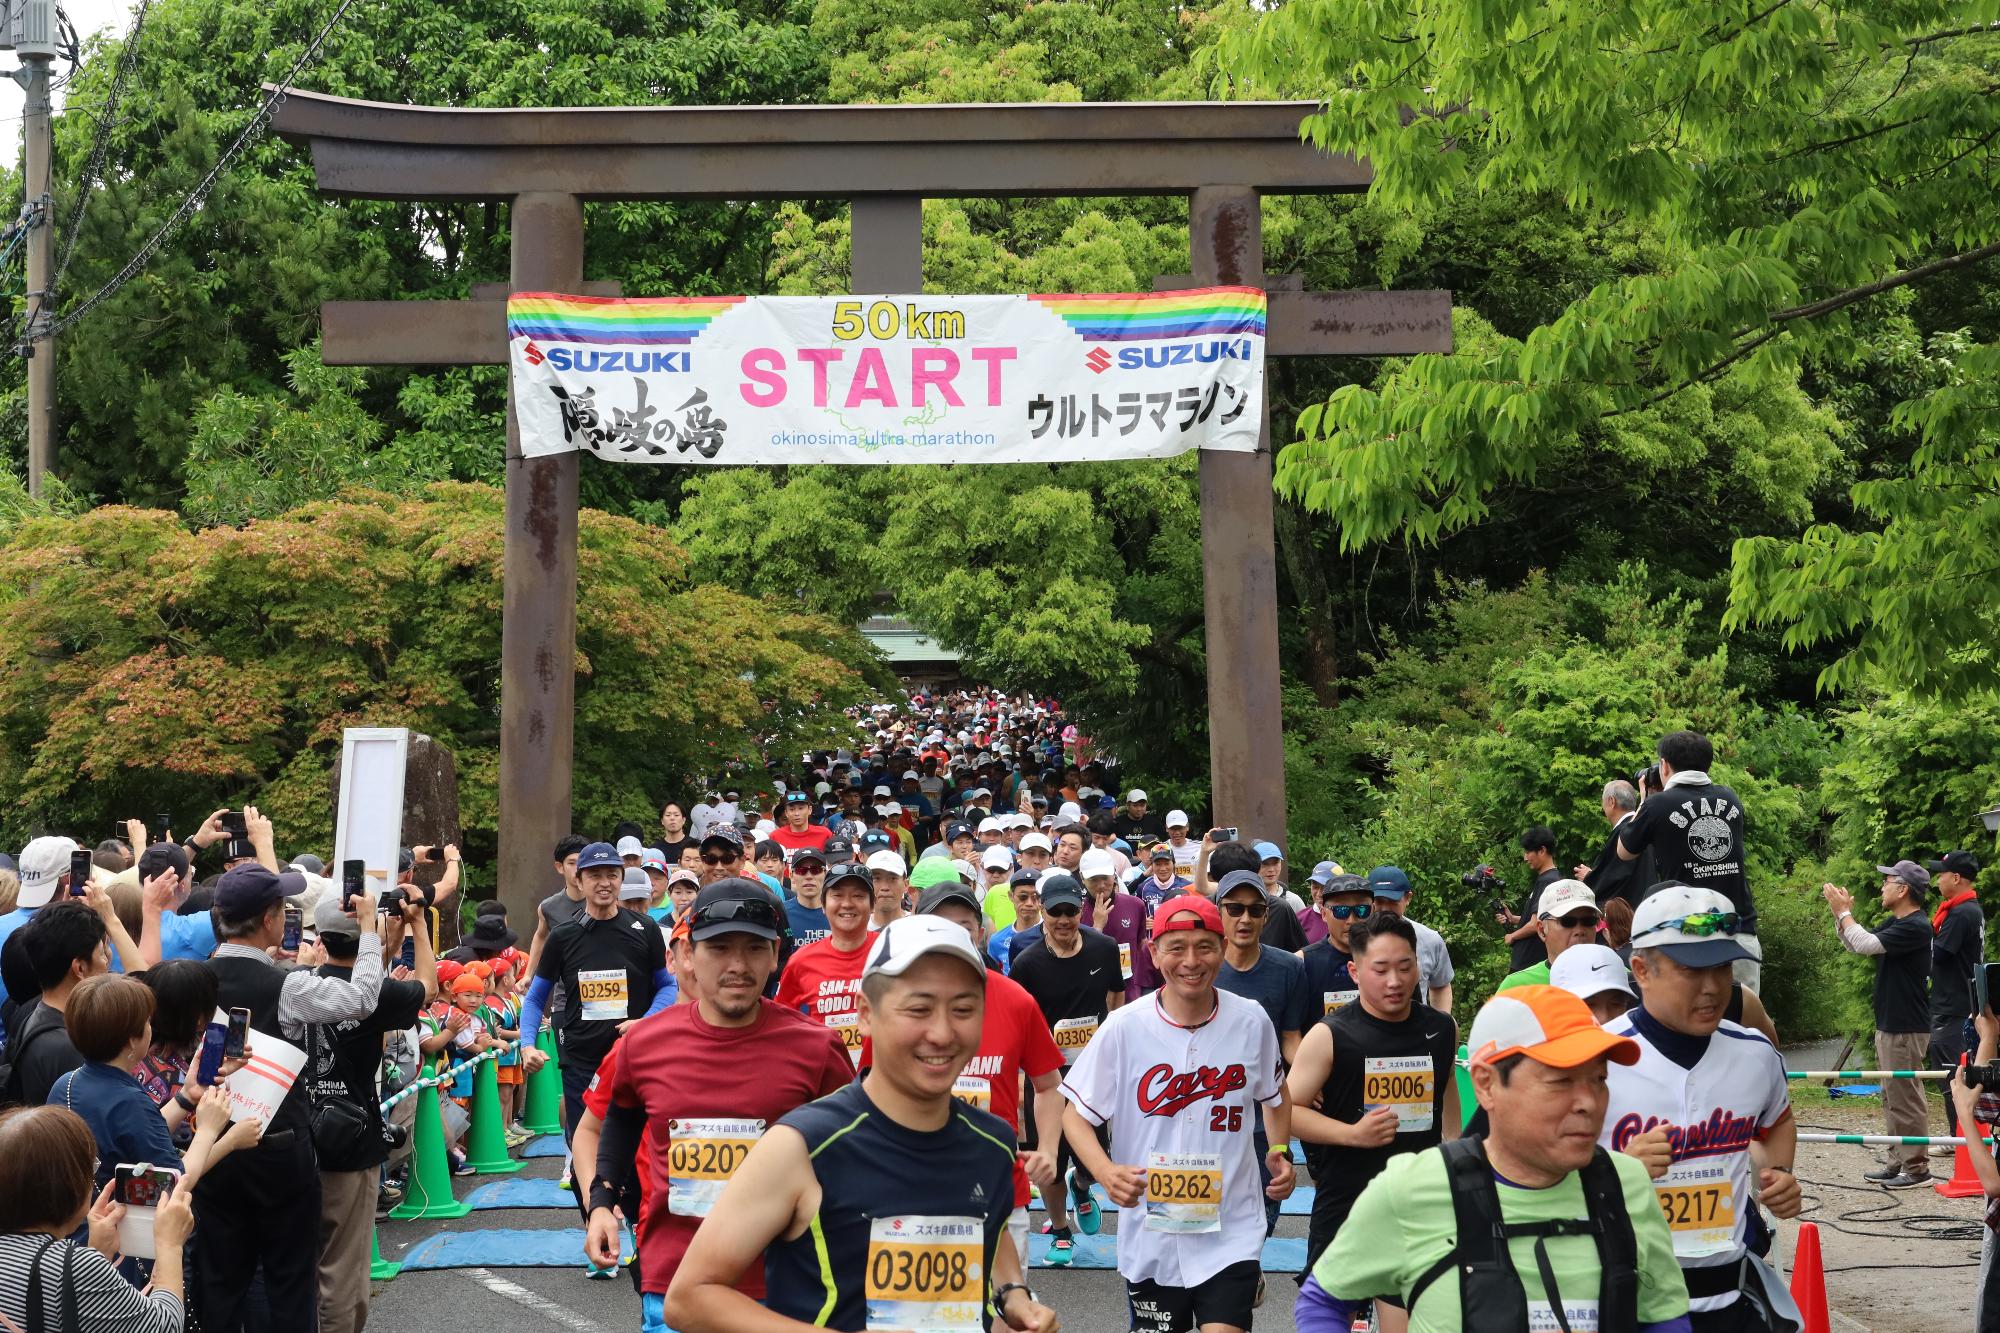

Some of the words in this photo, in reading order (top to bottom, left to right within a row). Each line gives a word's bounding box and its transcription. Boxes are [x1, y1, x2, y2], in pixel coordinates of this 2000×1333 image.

[832, 301, 965, 340] 50km
[546, 347, 691, 373] SUZUKI
[1118, 338, 1251, 369] SUZUKI
[739, 347, 1017, 408] START
[1028, 380, 1249, 440] ウルトラマラソン
[771, 430, 857, 446] okinosima
[865, 429, 904, 446] ultra
[912, 430, 995, 446] marathon
[1668, 797, 1740, 829] STAFF
[1693, 862, 1739, 874] OKINOSHIMA
[804, 929, 824, 938] THE
[581, 982, 620, 999] 03259
[817, 995, 852, 1014] GODO
[1136, 1063, 1247, 1118] Carp
[1367, 1075, 1425, 1099] 03006
[1209, 1105, 1244, 1132] 25
[1150, 1173, 1211, 1199] 03262
[1660, 1189, 1720, 1224] 3217
[872, 1249, 967, 1293] 03098
